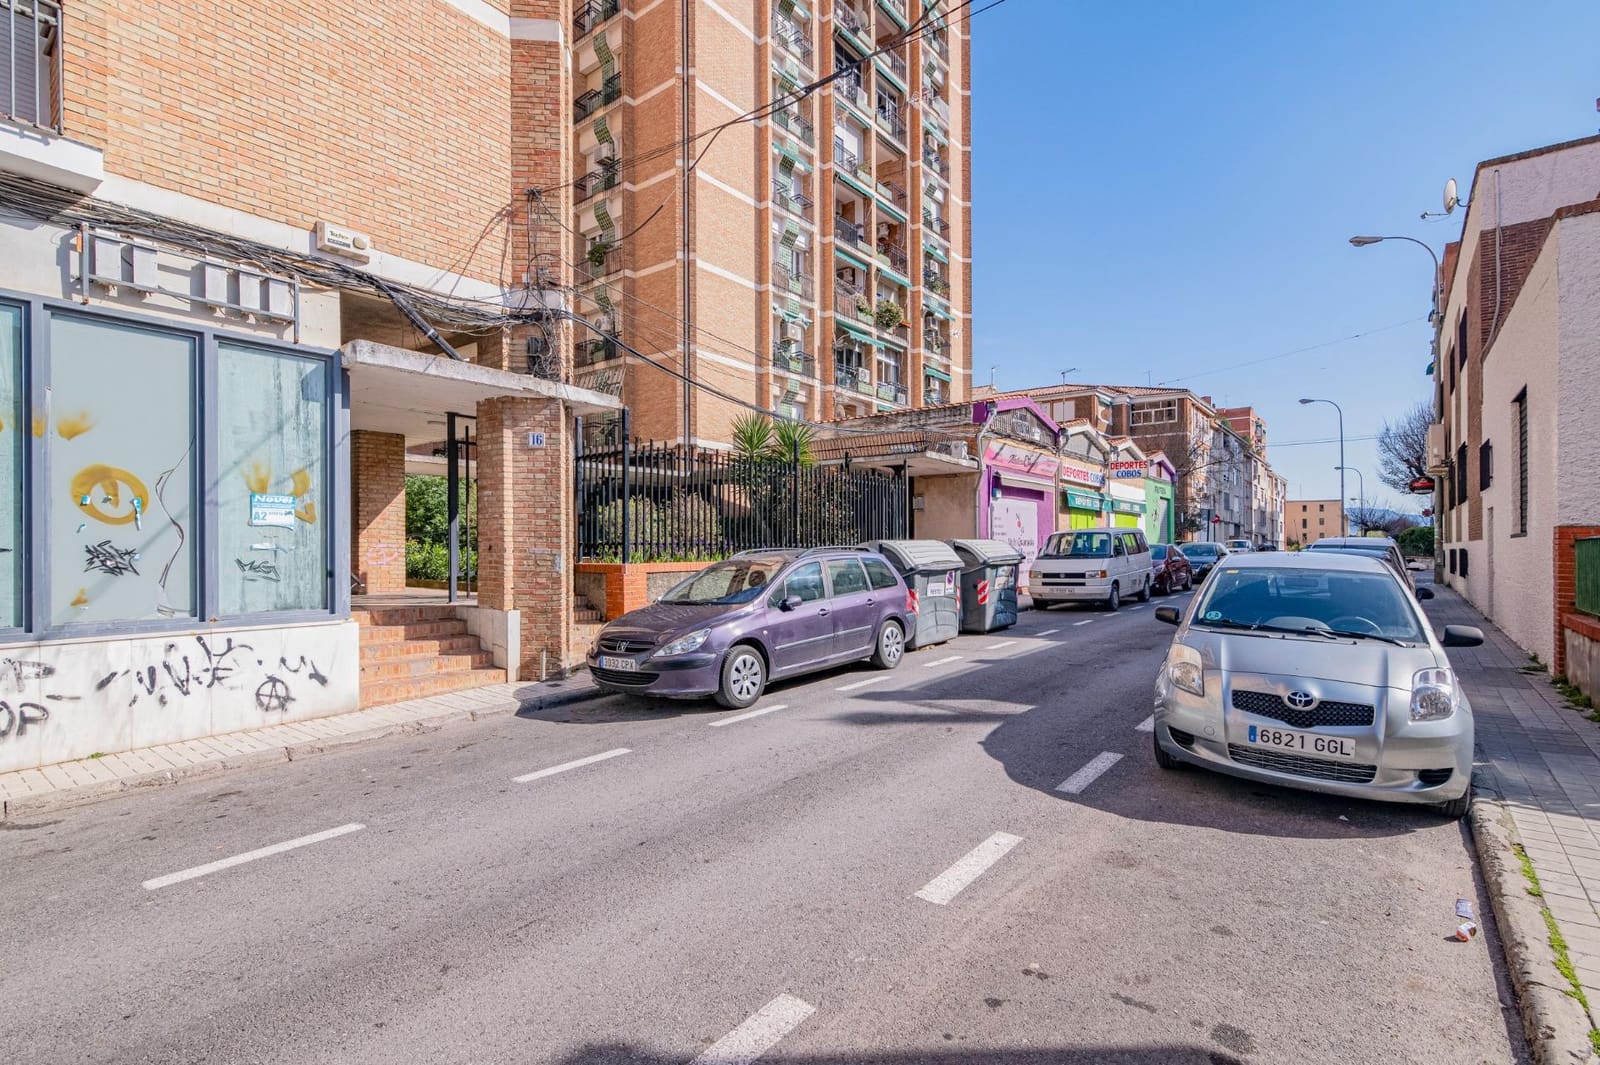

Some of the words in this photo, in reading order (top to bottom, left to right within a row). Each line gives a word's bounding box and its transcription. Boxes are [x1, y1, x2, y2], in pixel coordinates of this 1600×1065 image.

[532, 434, 543, 445] 16
[1110, 461, 1148, 470] DEPORTES
[1063, 465, 1089, 482] DEPORTES
[1116, 469, 1142, 479] COBOS
[1260, 729, 1305, 749] 6821
[1314, 737, 1351, 756] GGL
